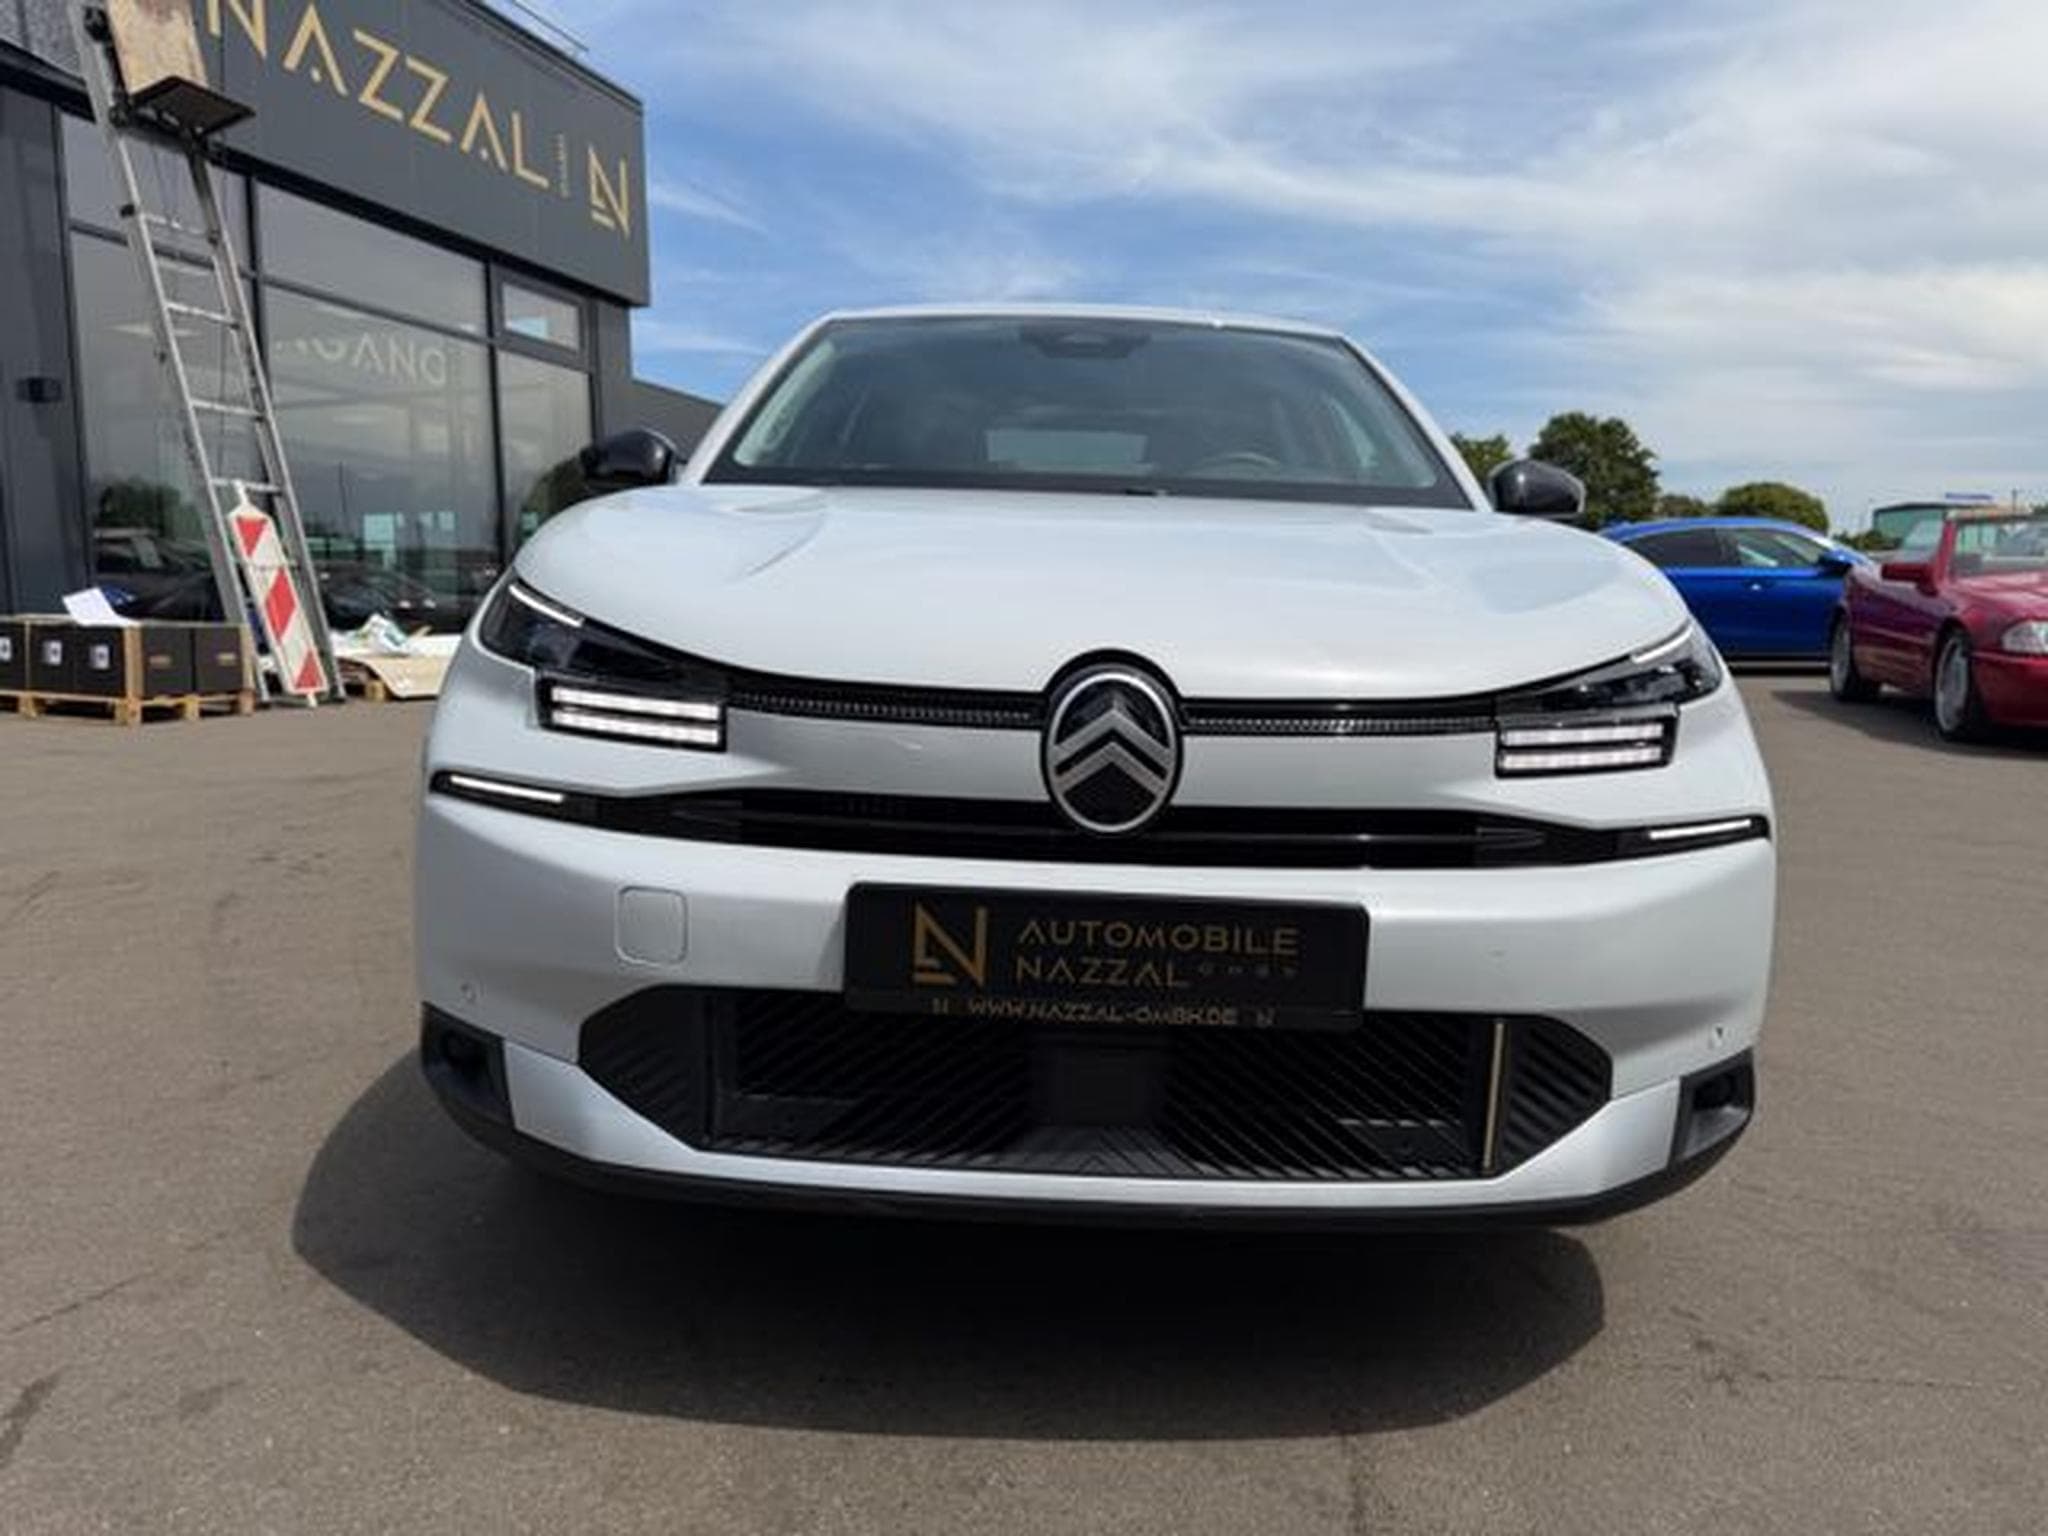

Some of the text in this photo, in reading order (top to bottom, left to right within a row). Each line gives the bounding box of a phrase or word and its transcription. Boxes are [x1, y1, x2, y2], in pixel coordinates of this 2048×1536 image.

[206, 0, 548, 186] NAZZAL
[1020, 920, 1299, 955] AUTOMOBILE
[1017, 957, 1190, 988] NAZZAL
